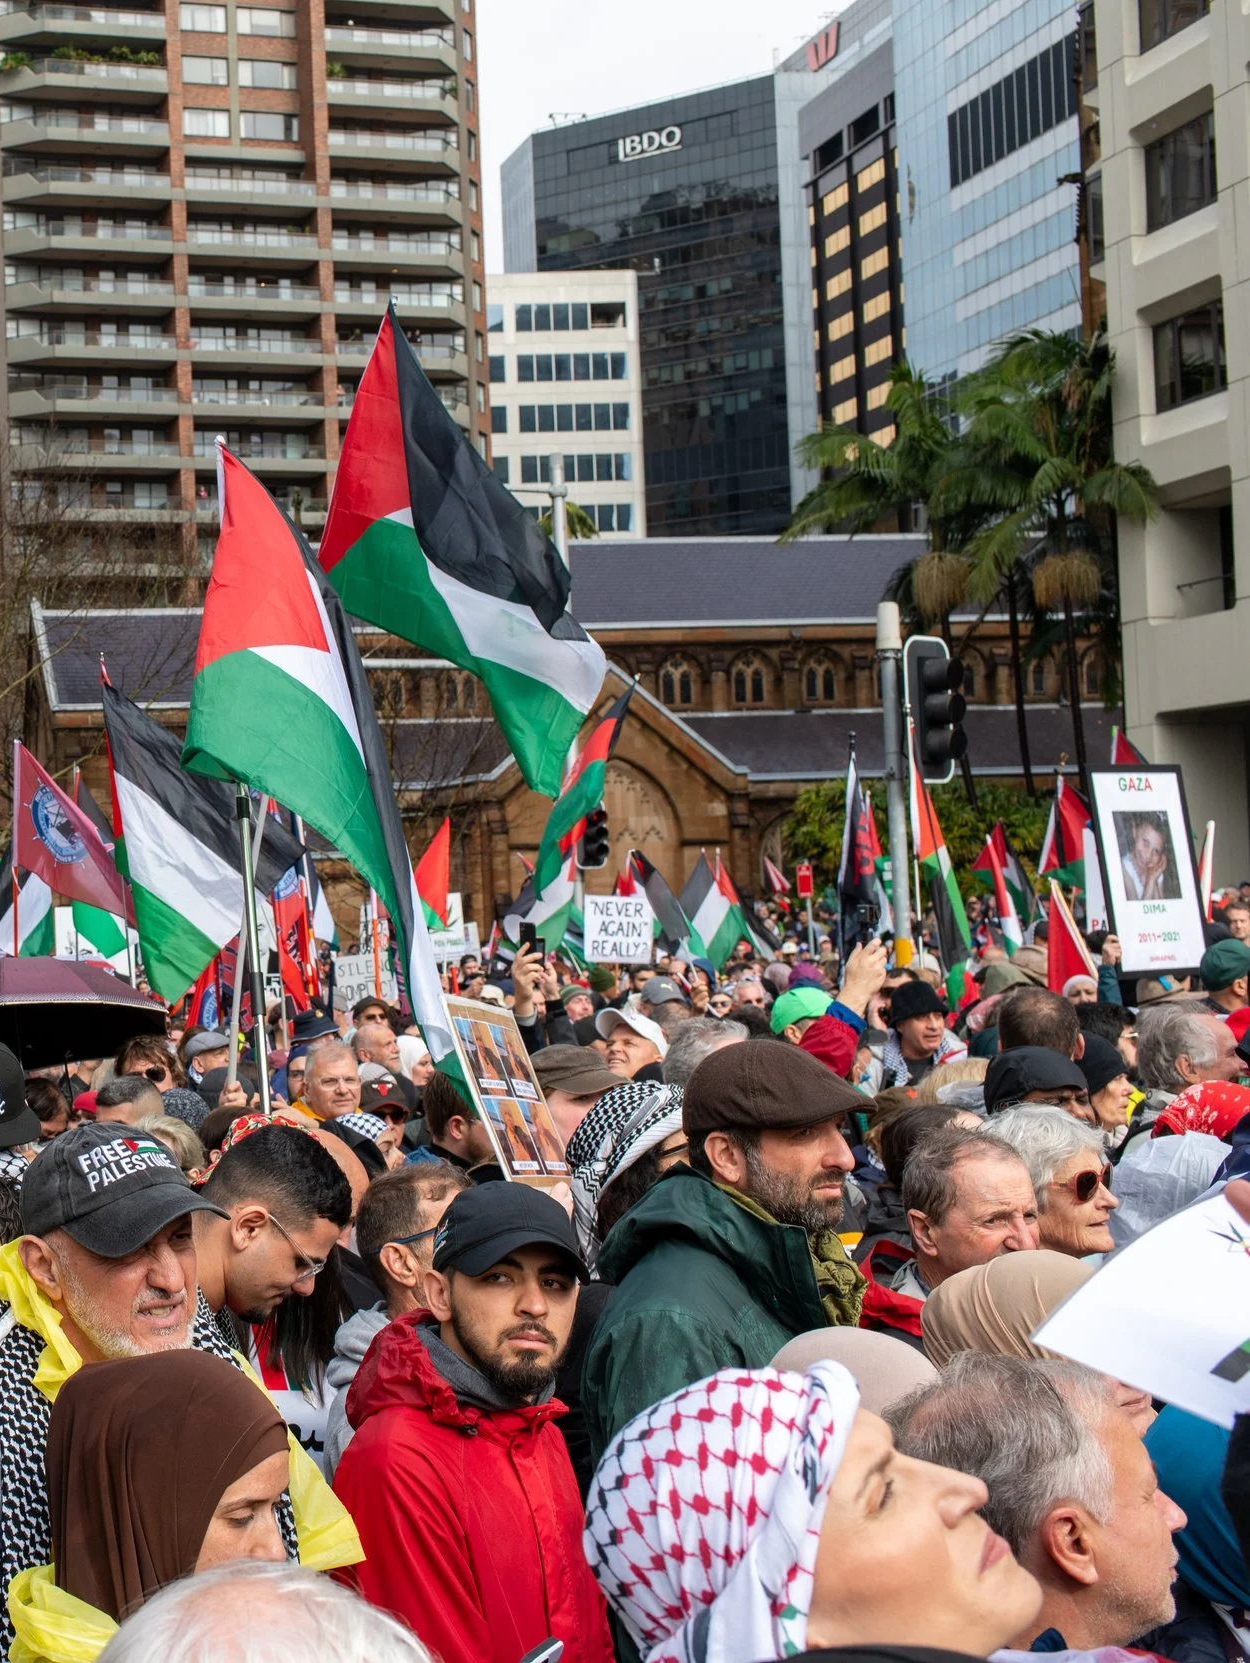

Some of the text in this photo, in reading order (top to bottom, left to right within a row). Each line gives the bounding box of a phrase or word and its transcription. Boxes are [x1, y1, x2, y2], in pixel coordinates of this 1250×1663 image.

[624, 125, 682, 156] BDO
[1118, 776, 1153, 792] GAZA
[1142, 903, 1168, 914] DIMA
[591, 940, 648, 957] REALLY?
[77, 1138, 133, 1174] FREE
[85, 1151, 177, 1193] PALESTINE
